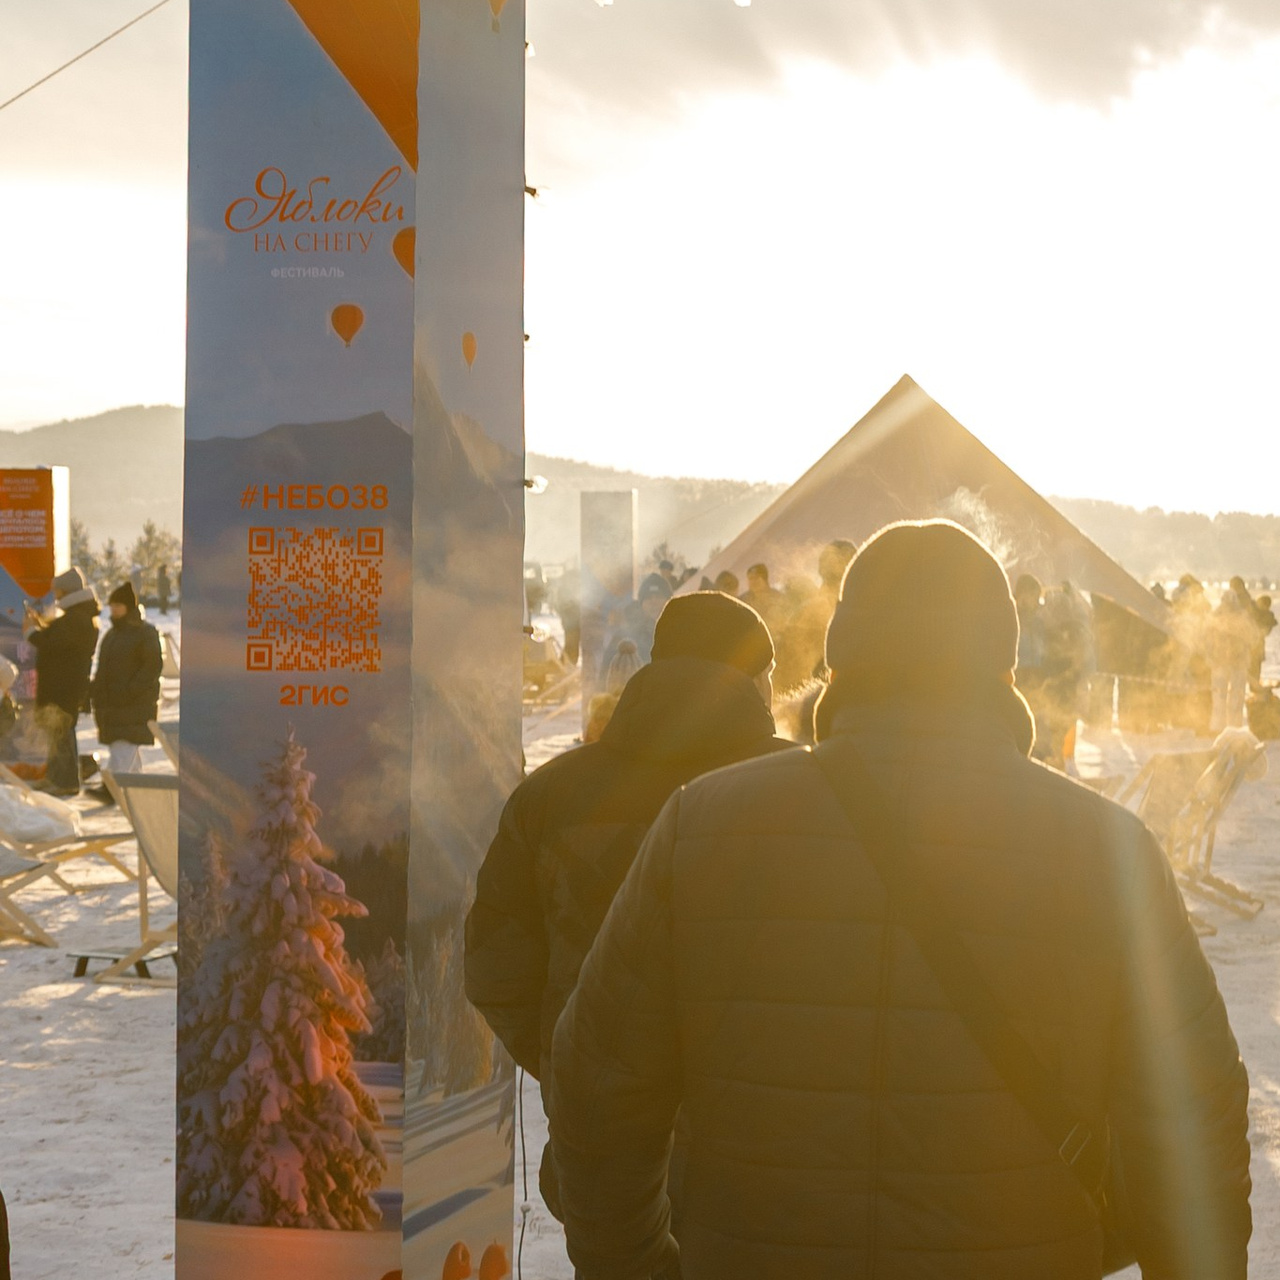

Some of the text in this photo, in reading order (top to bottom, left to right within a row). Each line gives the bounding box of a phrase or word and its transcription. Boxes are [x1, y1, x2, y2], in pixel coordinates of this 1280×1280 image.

[225, 165, 404, 234] Яблоки
[253, 231, 374, 255] НА СНЕГУ
[270, 266, 345, 280] ФЕСТИВАЛЬ
[240, 483, 389, 510] #НЕБО38
[278, 684, 350, 706] 2ГИС
